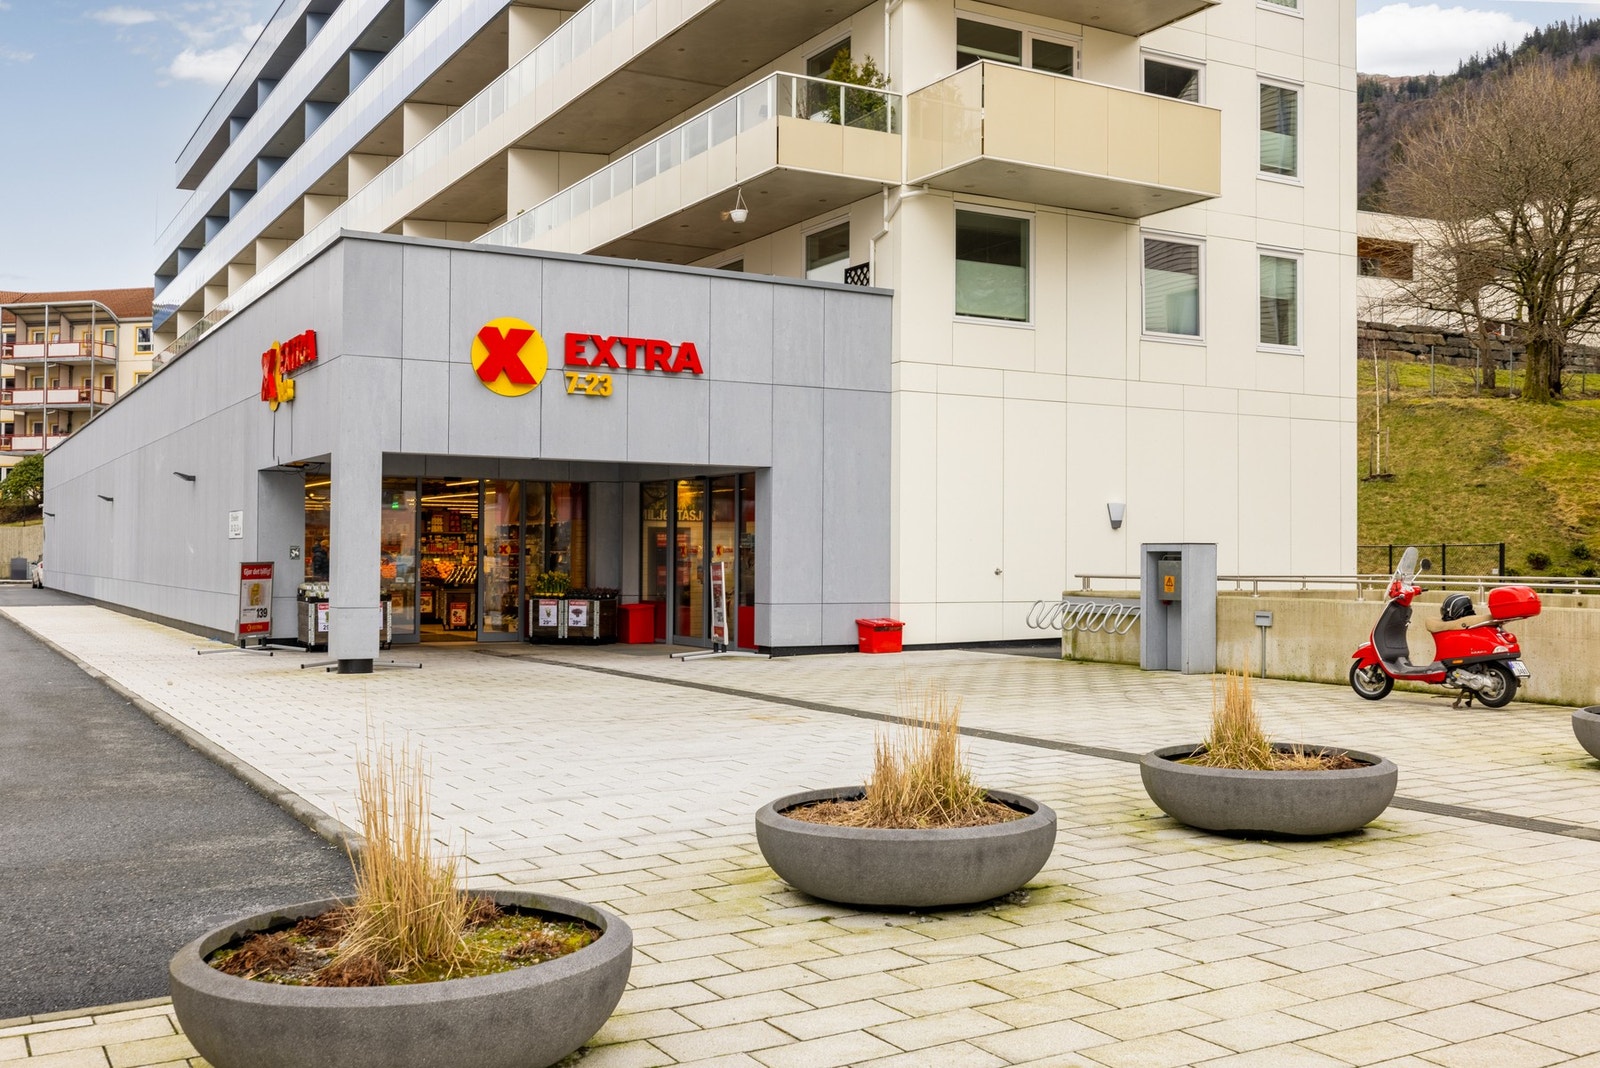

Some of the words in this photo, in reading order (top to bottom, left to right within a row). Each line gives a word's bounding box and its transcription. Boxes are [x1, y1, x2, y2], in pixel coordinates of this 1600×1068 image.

[476, 326, 537, 385] X
[565, 332, 703, 374] EXTRA
[565, 372, 613, 397] 7-23
[256, 607, 268, 618] 139
